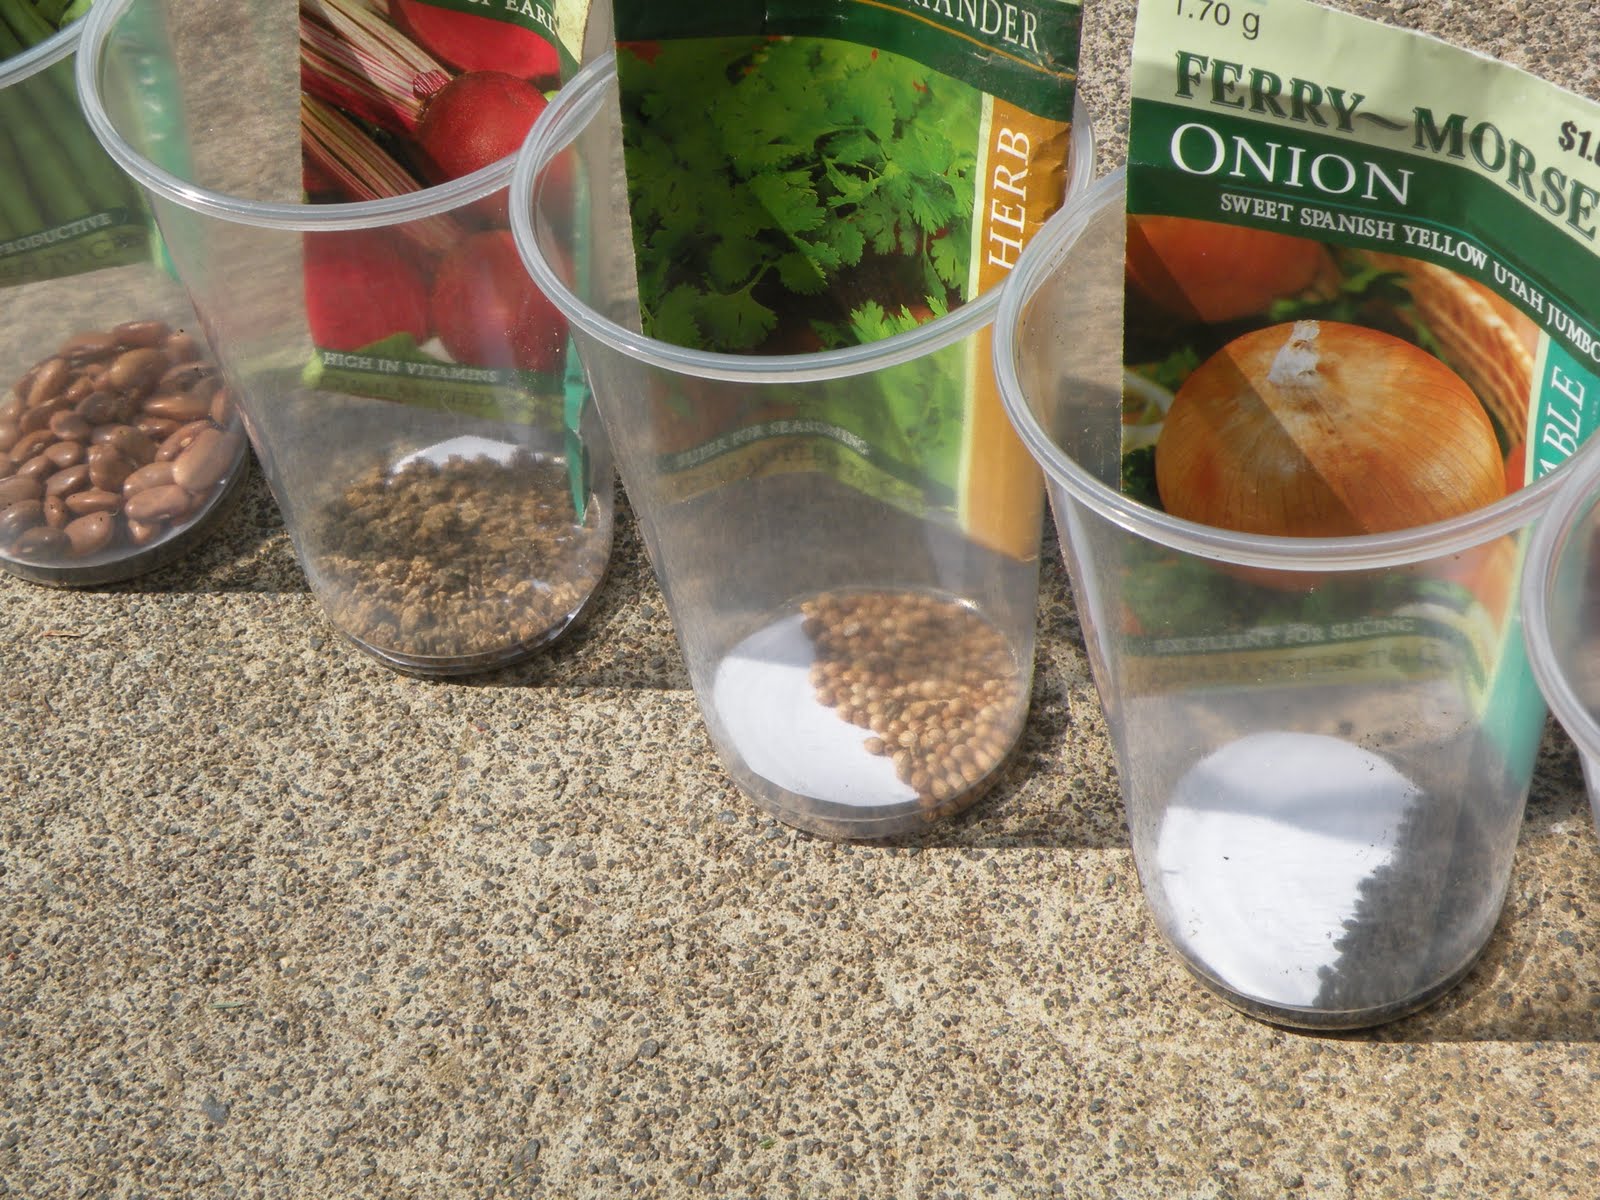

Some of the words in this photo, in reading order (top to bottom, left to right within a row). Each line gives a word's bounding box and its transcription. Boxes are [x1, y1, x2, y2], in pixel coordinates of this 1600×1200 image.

[911, 0, 1039, 54] ANDER
[988, 127, 1030, 270] HERB
[1170, 122, 1415, 206] ONION
[1411, 106, 1600, 242] MORSE
[0, 212, 112, 256] RODUCTIVE
[1220, 192, 1294, 222] SWEET
[1300, 207, 1396, 241] SPANISH
[1402, 224, 1488, 271] YELLOW
[1493, 260, 1544, 314] UTAH
[323, 351, 372, 369] HIGH
[378, 359, 400, 373] IN
[1284, 622, 1325, 645] FOR
[1330, 618, 1415, 640] SLICING
